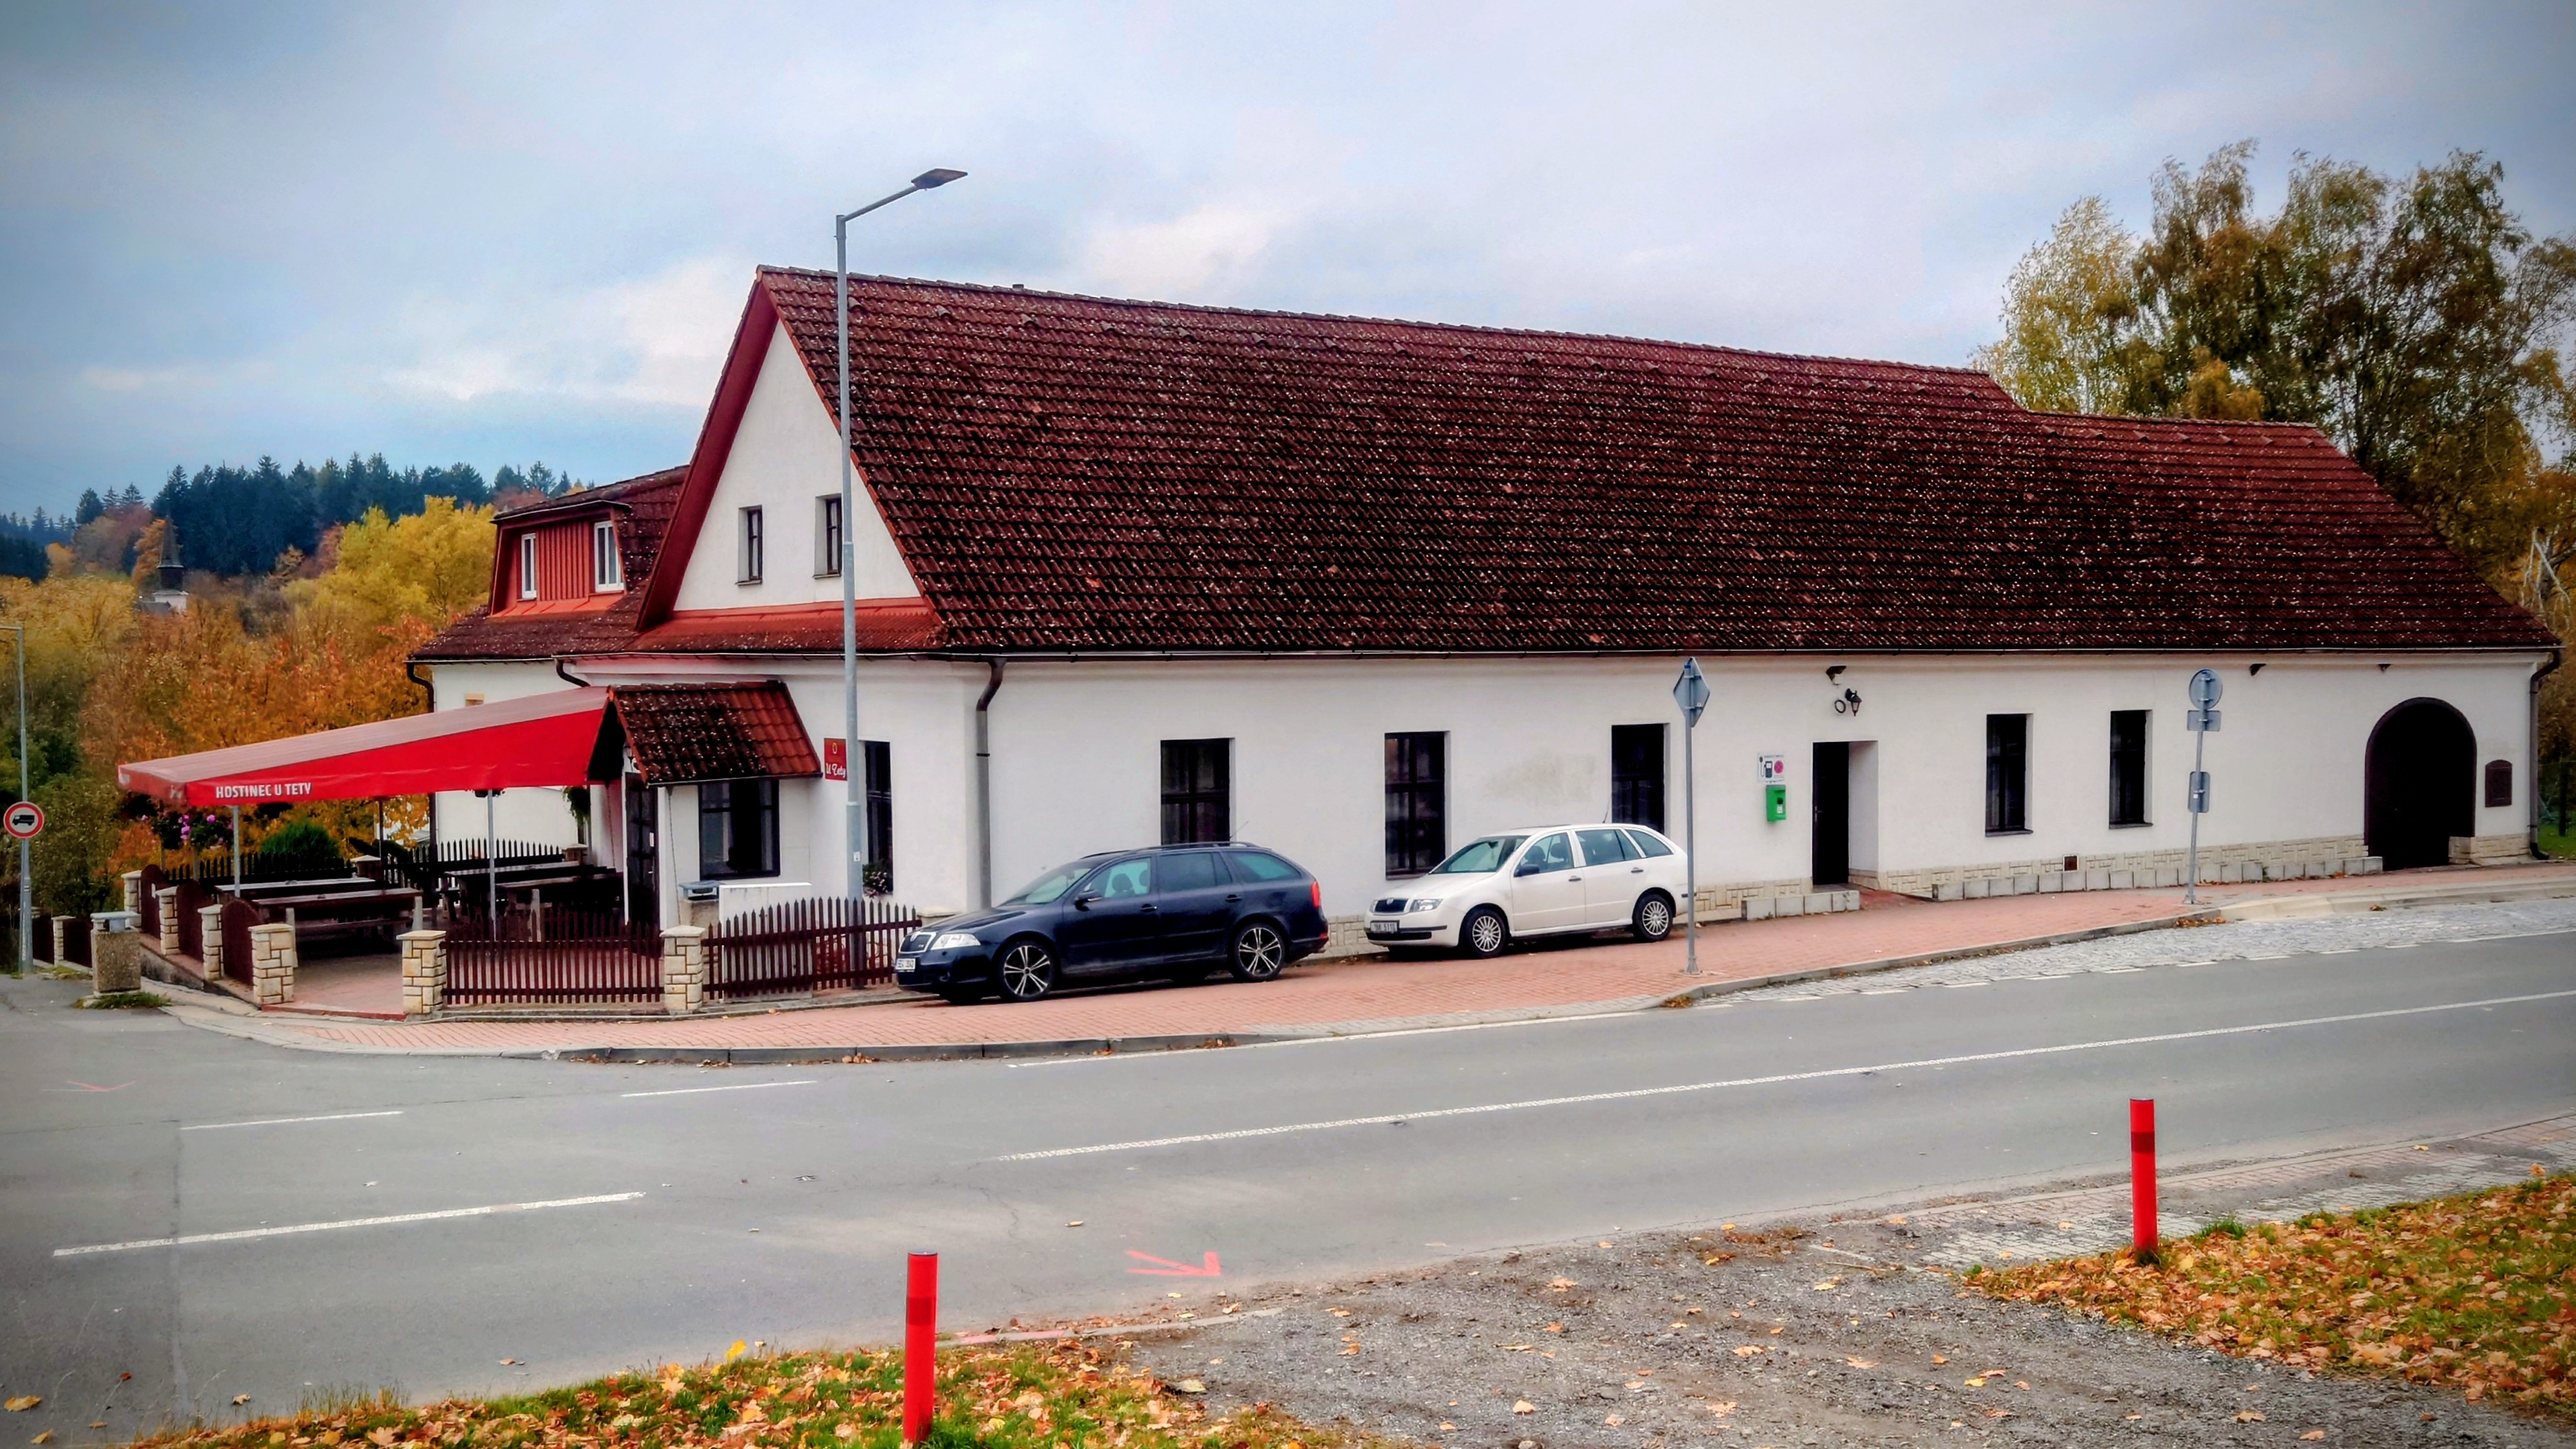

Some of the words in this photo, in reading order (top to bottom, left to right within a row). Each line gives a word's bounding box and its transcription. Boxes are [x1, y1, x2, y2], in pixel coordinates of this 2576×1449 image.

[825, 763, 832, 774] U
[216, 784, 272, 798] HOSTINEC
[274, 783, 282, 796] U
[285, 782, 311, 795] TETY
